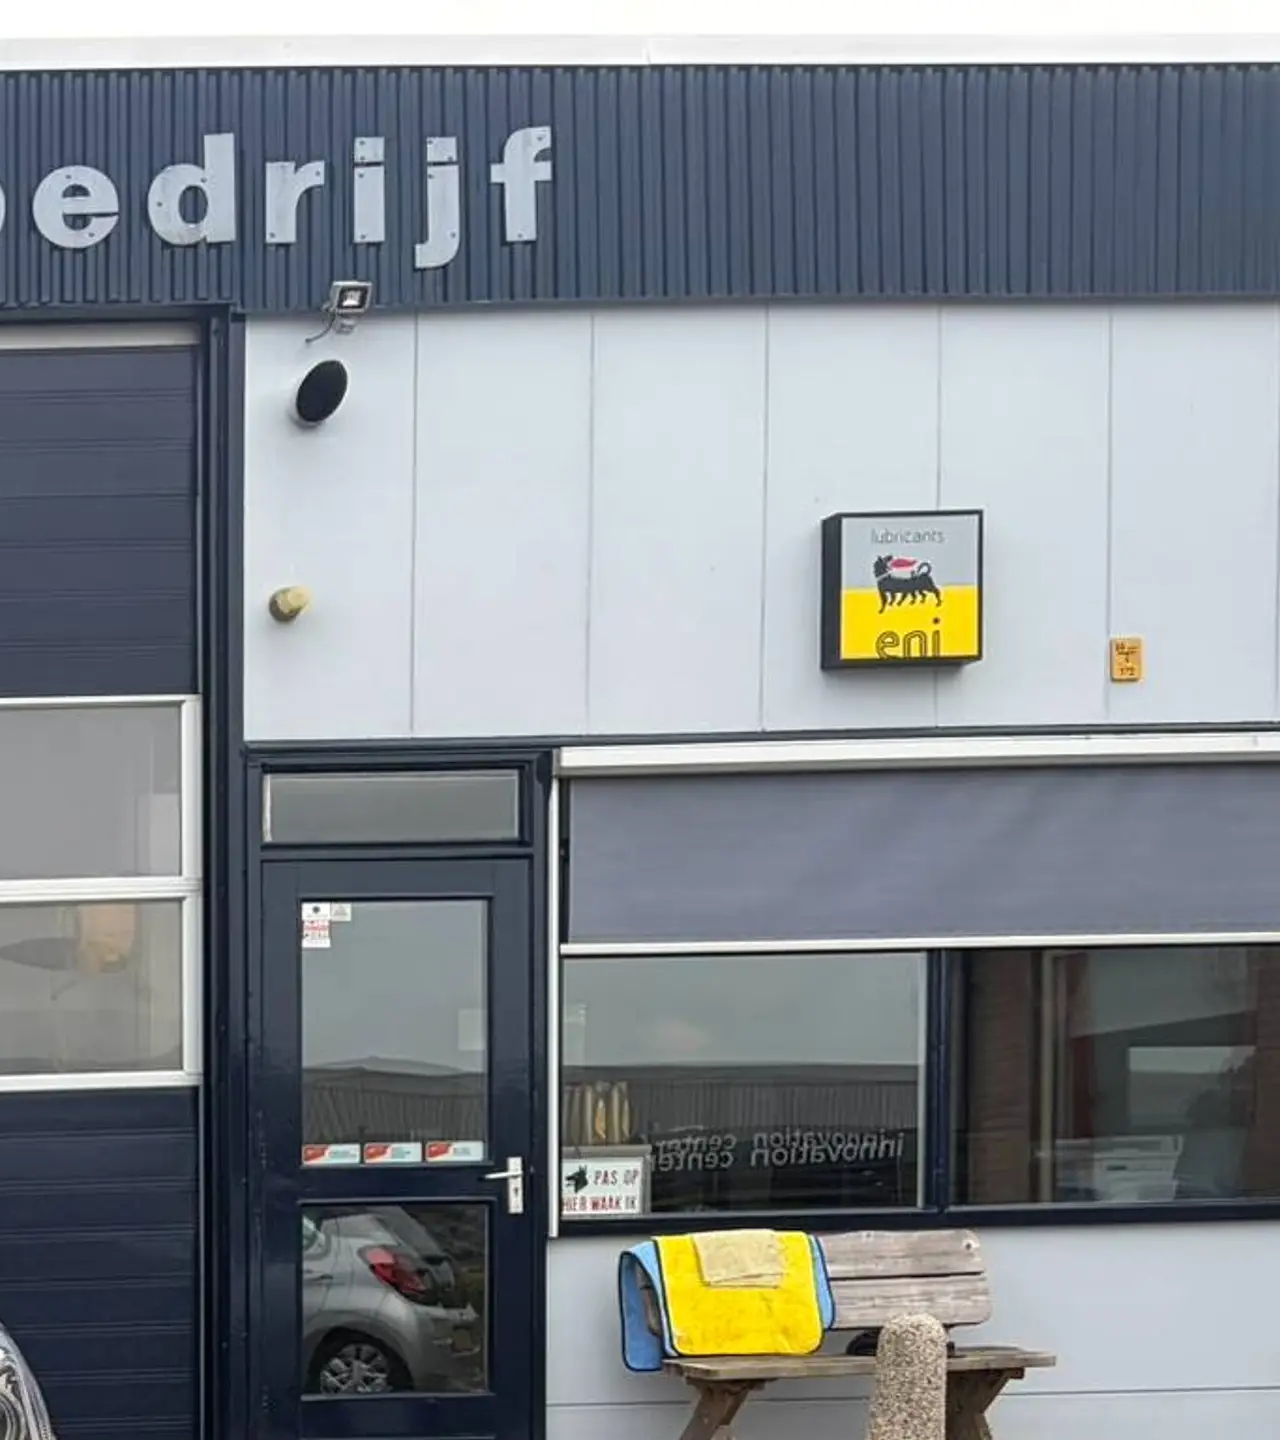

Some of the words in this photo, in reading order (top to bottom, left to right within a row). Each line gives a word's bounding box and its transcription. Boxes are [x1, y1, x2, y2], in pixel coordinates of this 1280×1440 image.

[870, 527, 944, 544] lubricants
[875, 617, 941, 660] eni
[593, 1169, 618, 1186] PAS
[623, 1168, 639, 1186] OP
